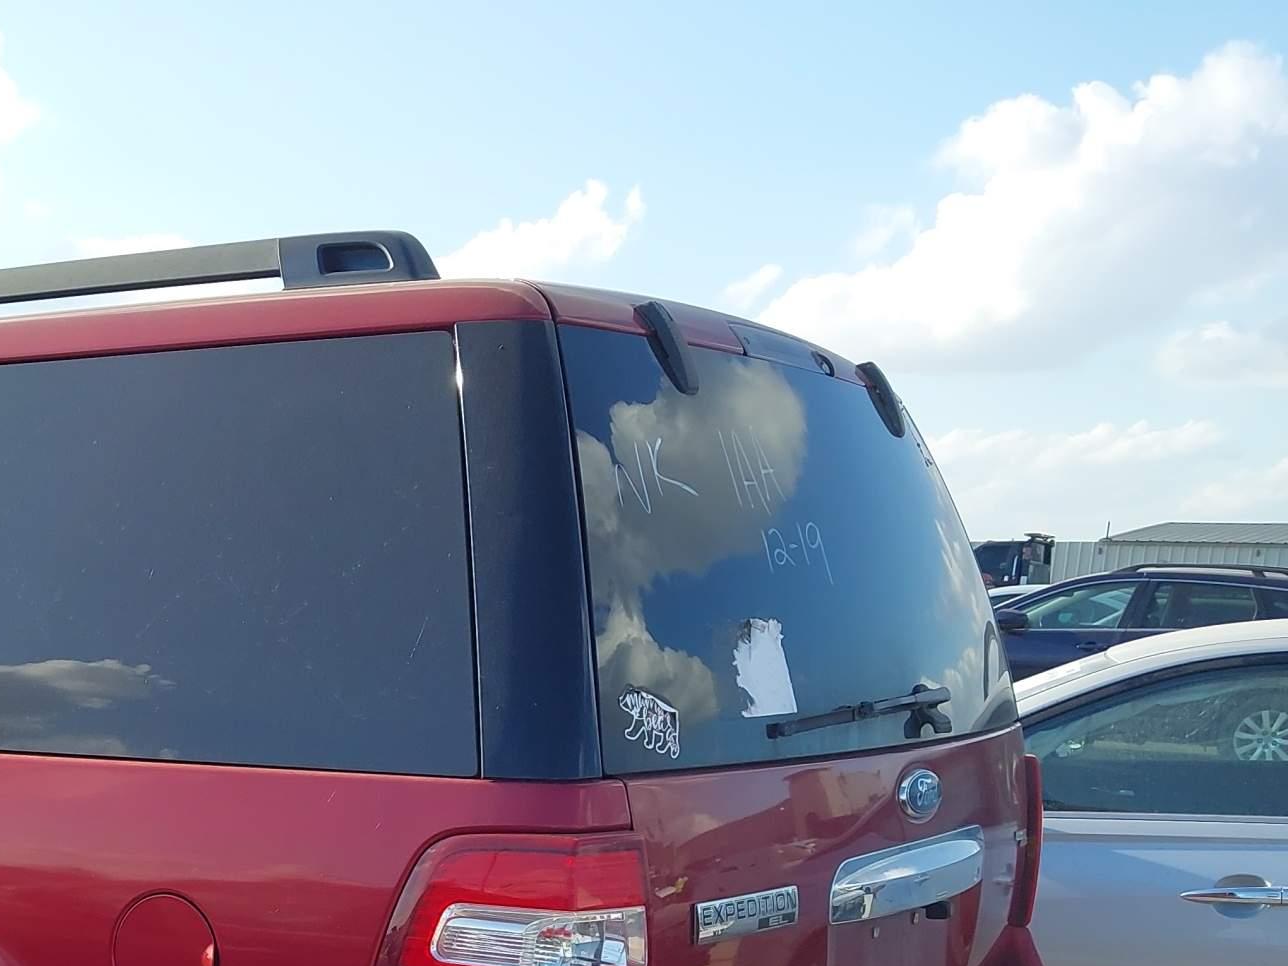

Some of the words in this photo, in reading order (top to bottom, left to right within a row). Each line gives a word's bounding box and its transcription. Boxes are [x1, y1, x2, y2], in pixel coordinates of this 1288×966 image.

[614, 437, 699, 514] NK
[718, 427, 786, 517] IAA
[761, 521, 834, 585] 12-19
[702, 889, 797, 926] EXPEDITION
[768, 915, 789, 926] EL
